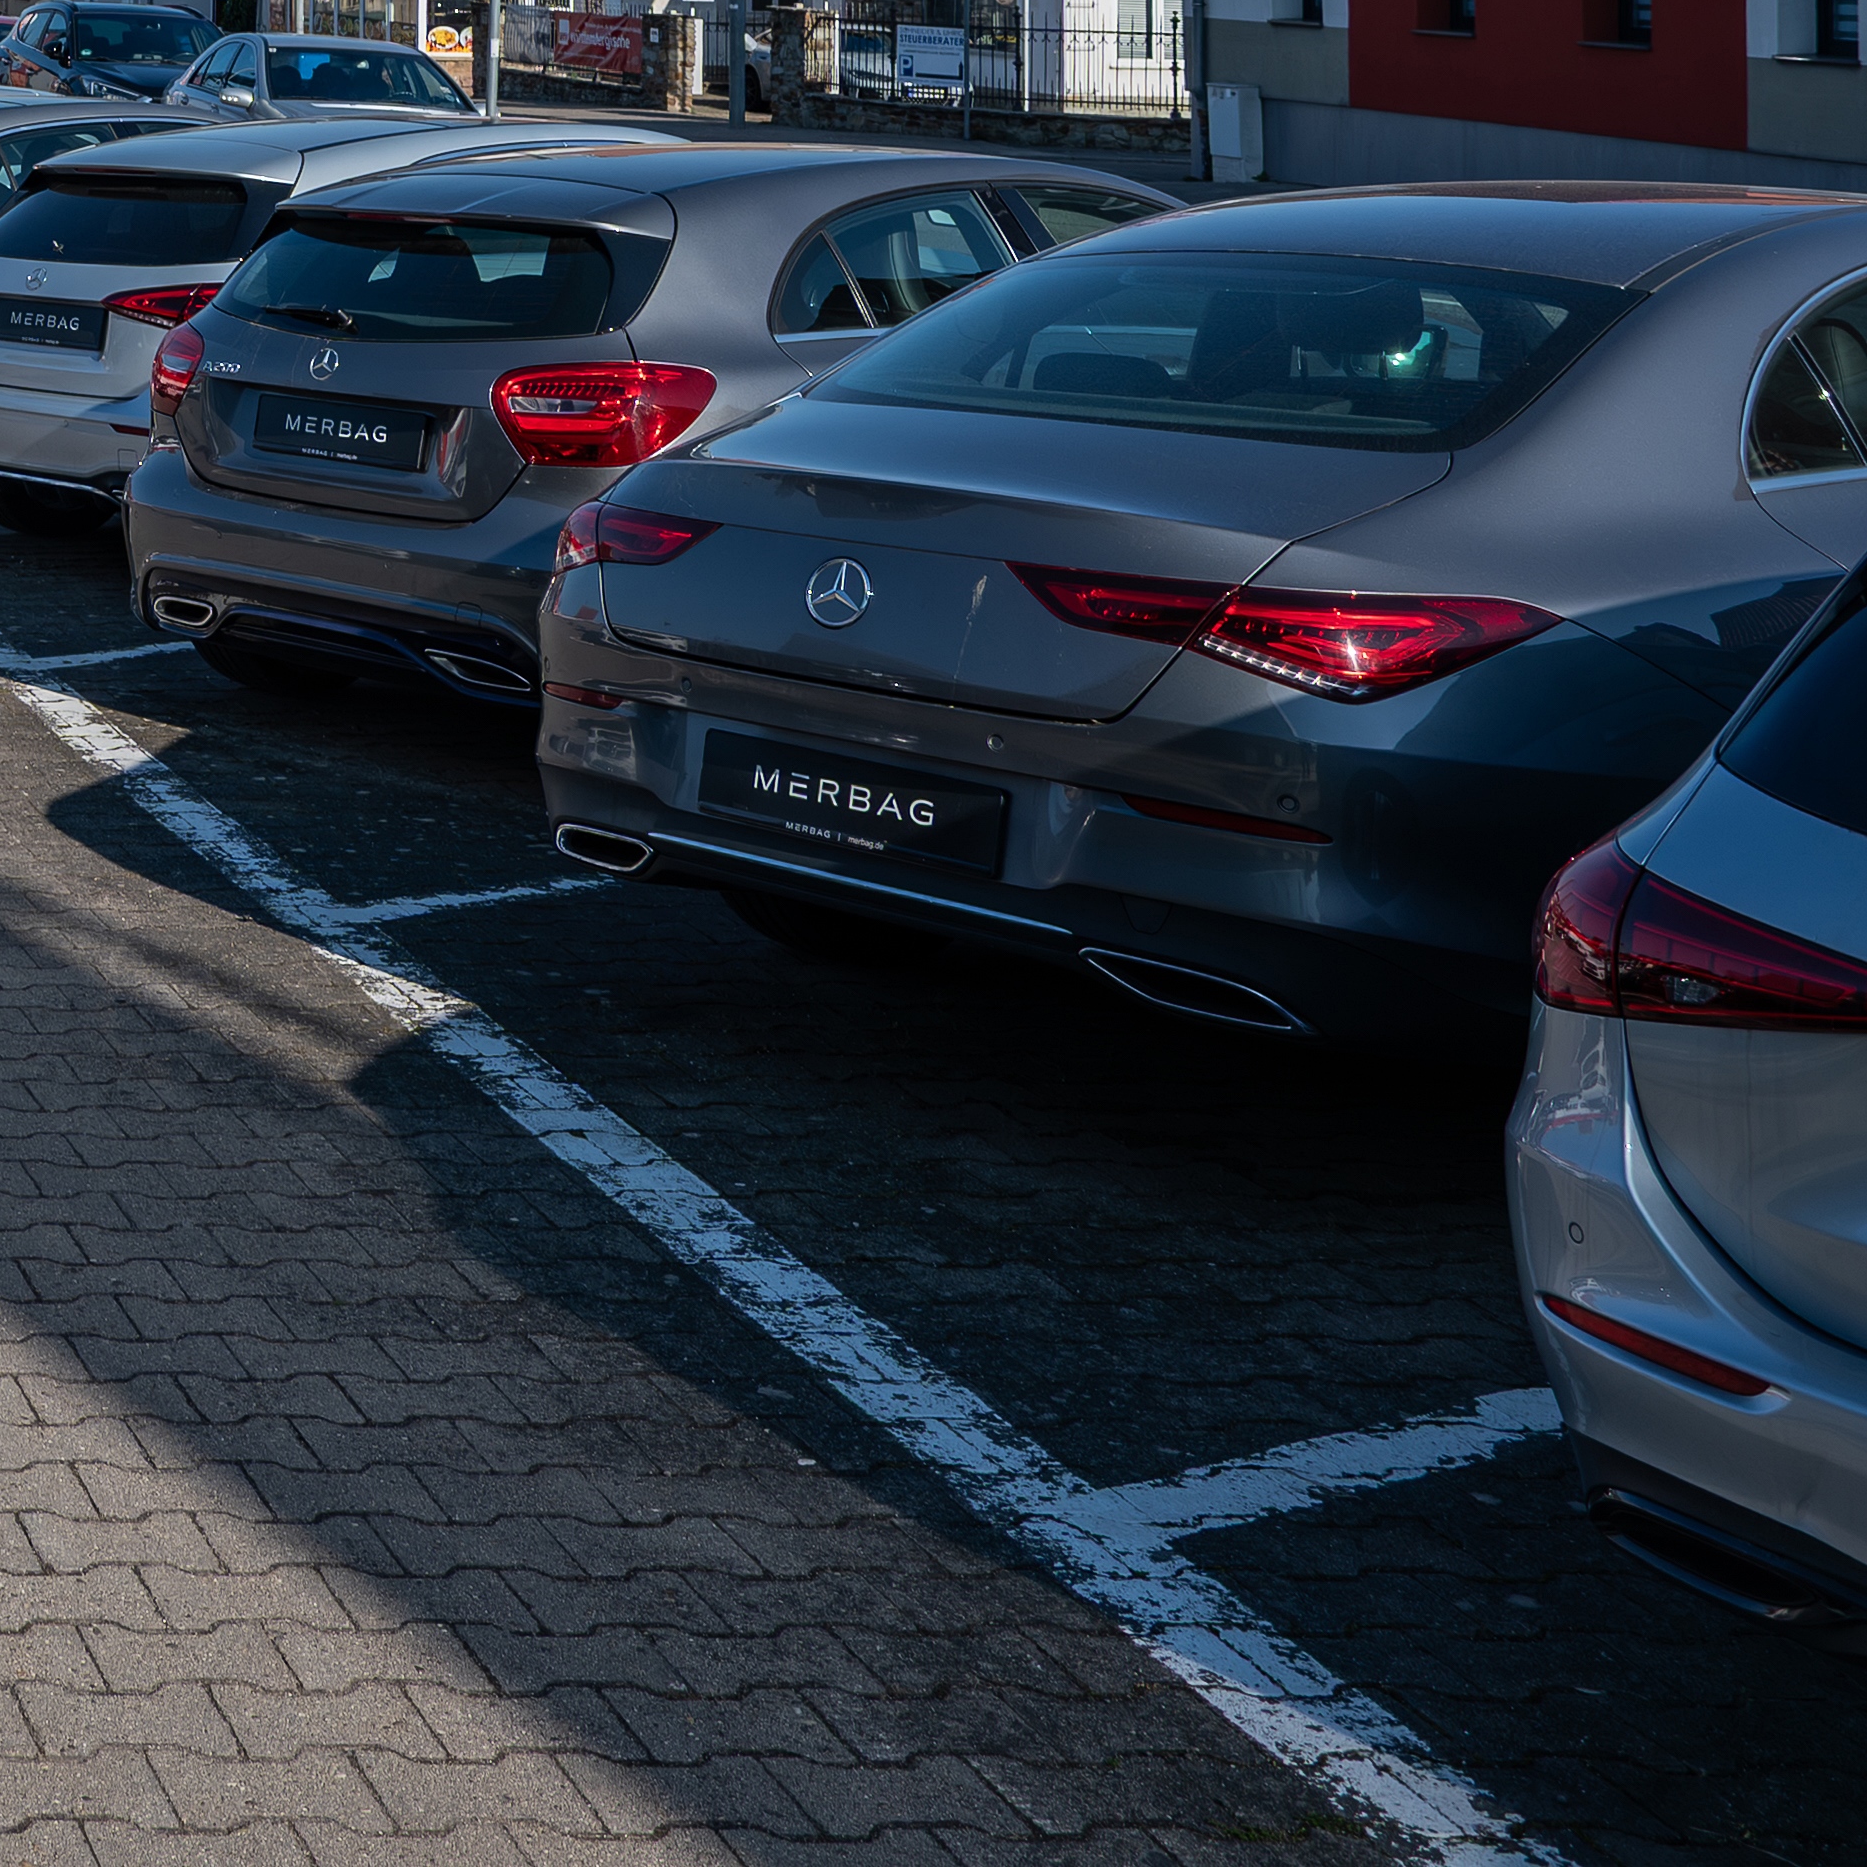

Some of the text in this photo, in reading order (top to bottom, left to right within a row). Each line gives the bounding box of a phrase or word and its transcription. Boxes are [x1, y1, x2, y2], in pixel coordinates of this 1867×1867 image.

[899, 34, 965, 46] STEUERBERATER
[900, 56, 913, 76] P
[10, 311, 81, 331] MERBAG
[285, 413, 388, 443] MERBAG
[752, 764, 936, 826] MERBAG
[785, 821, 885, 852] MERBAG merbag.de
